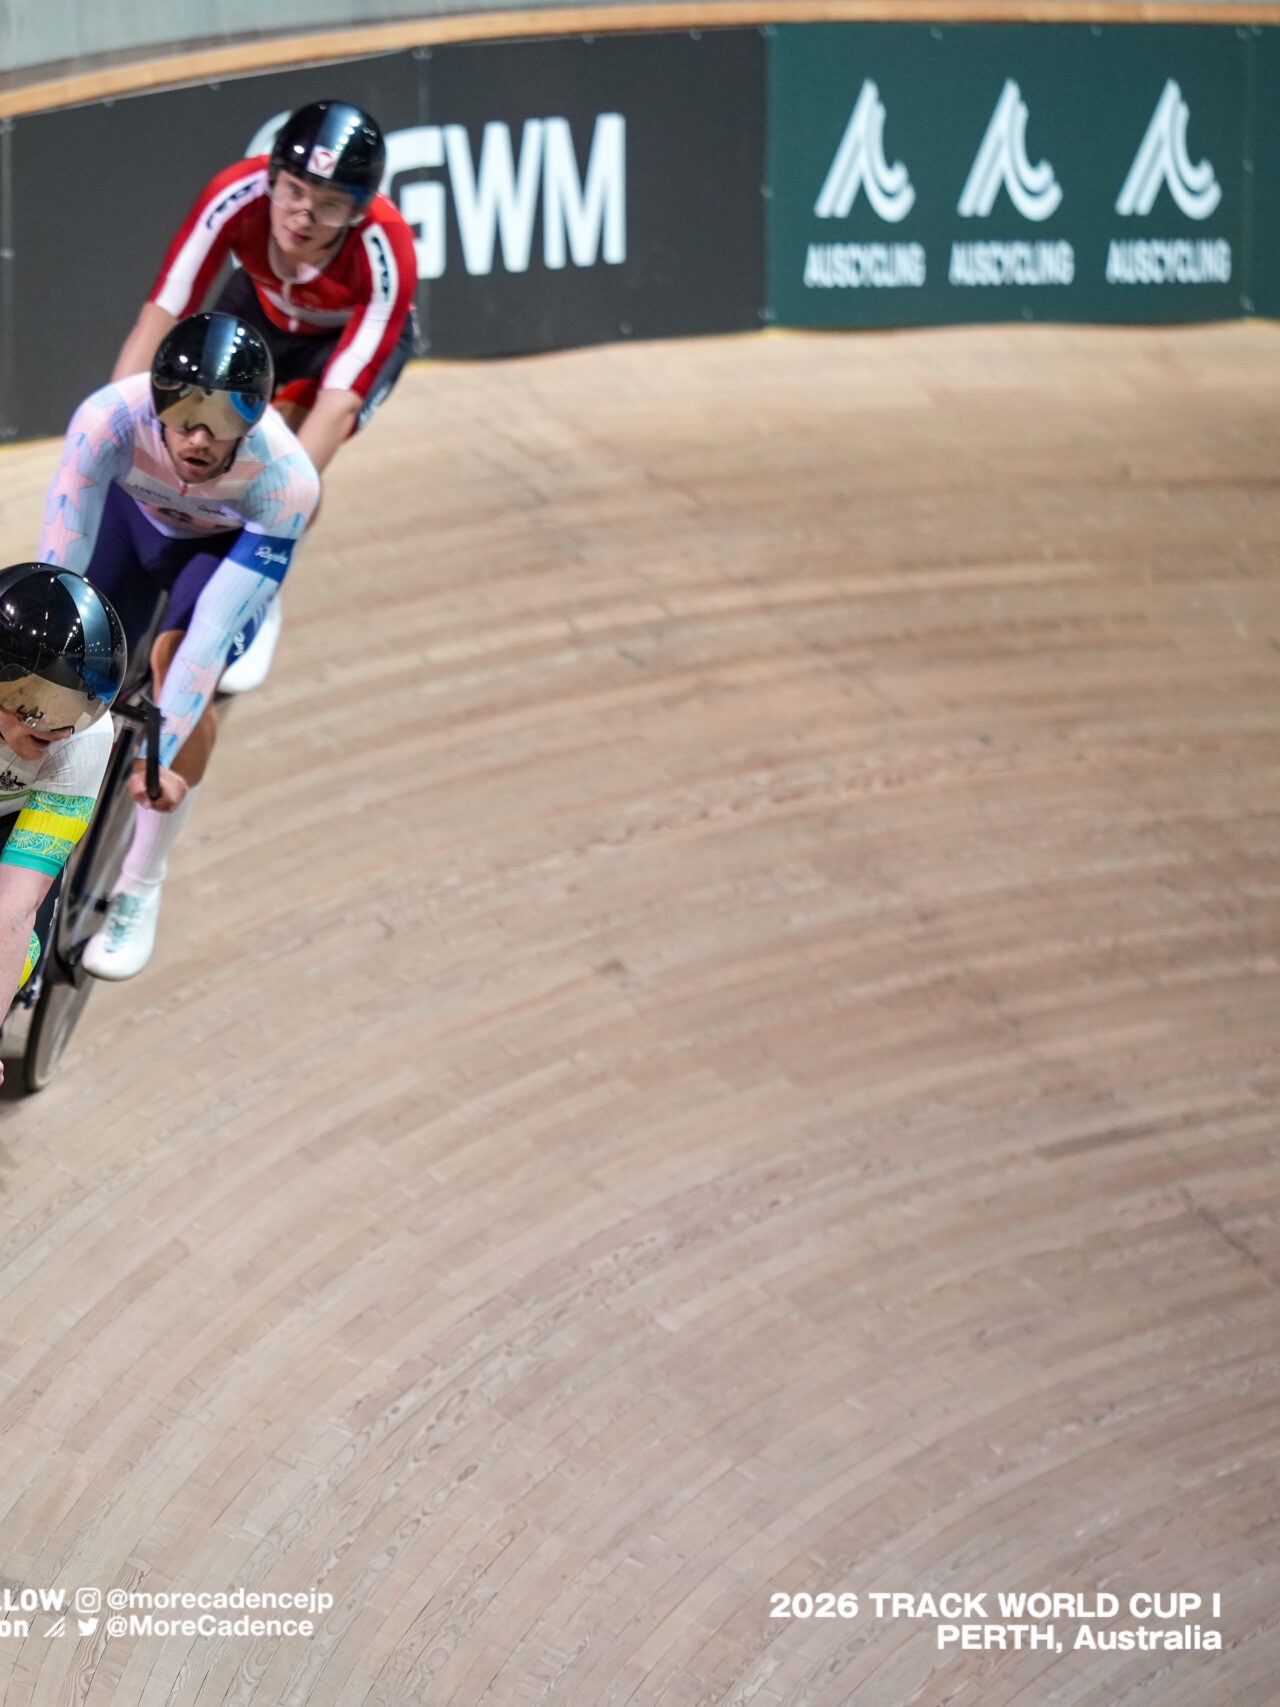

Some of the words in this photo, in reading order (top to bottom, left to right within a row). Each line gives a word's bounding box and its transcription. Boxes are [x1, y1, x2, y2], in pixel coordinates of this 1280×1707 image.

[379, 112, 627, 280] GWM
[804, 244, 926, 288] AUSCYCLING
[949, 241, 1074, 286] AUSCYCLING
[1106, 239, 1231, 285] AUSCYCLING
